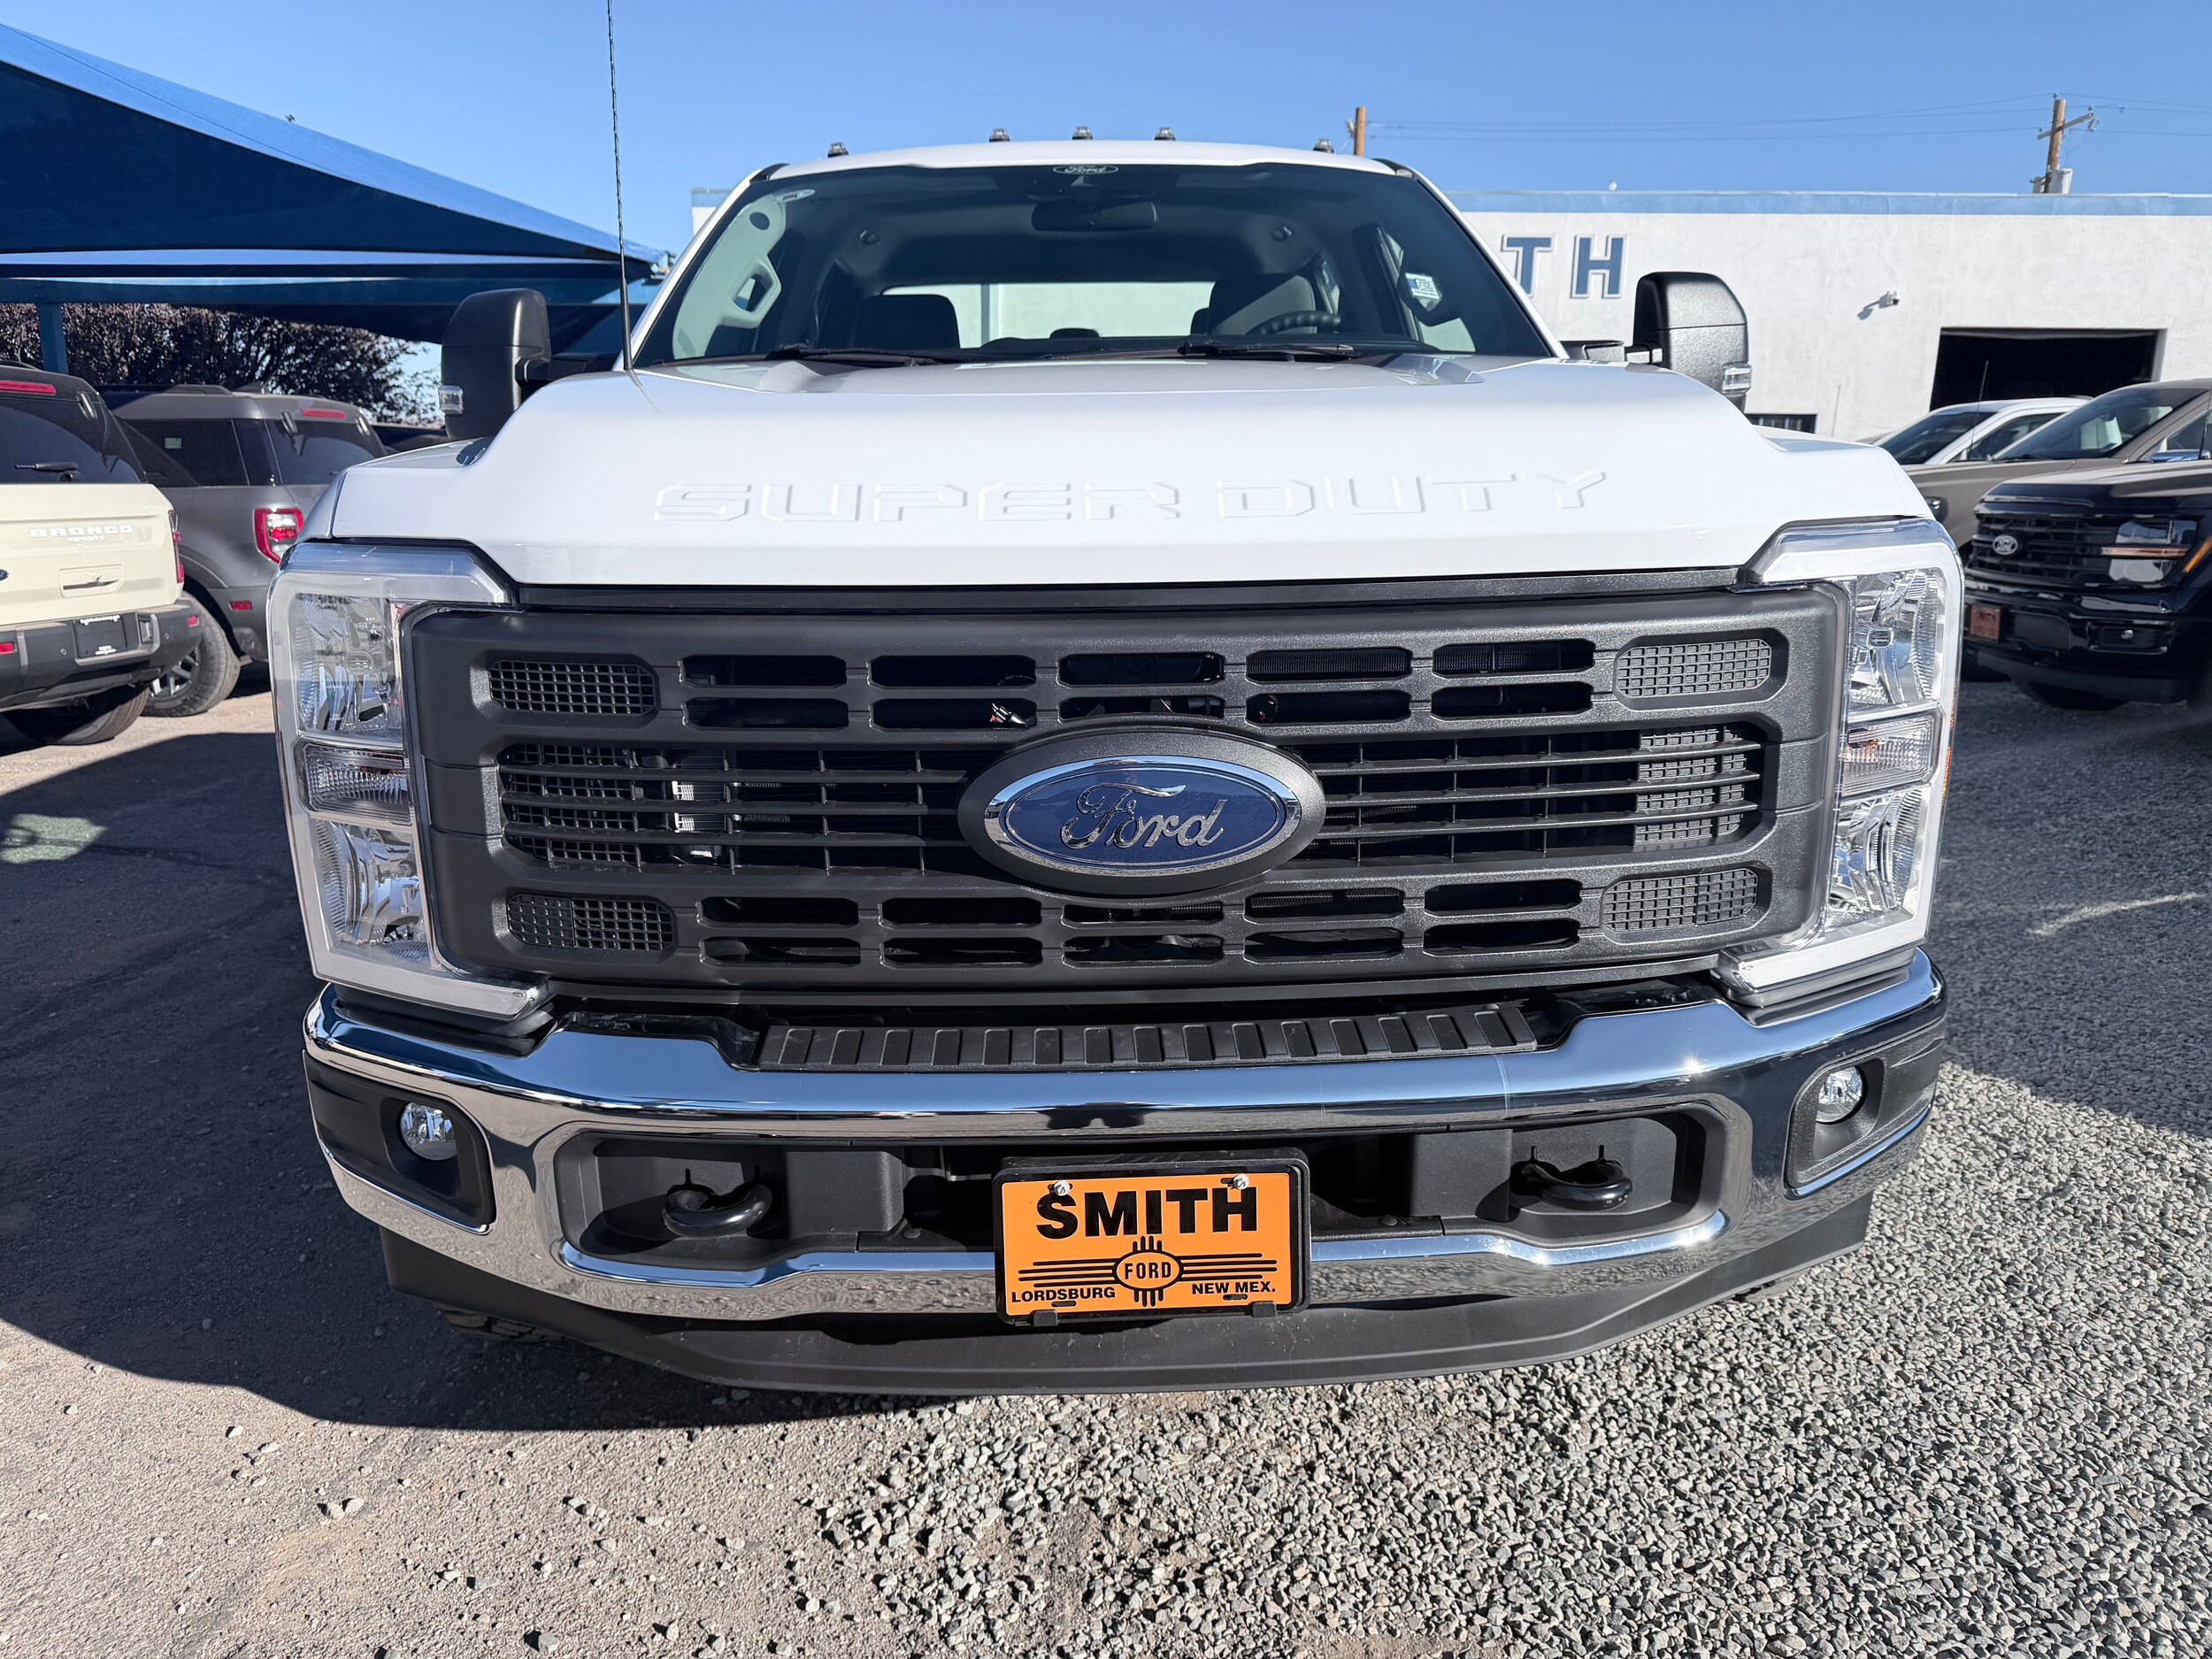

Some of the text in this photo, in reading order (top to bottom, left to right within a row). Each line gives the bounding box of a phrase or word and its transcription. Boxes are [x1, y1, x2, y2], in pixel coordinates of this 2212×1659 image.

[653, 471, 1607, 523] SUPER DUTY
[29, 525, 133, 537] BRONCO
[1060, 781, 1227, 849] Ford
[1035, 1187, 1258, 1240] SMITH
[1125, 1262, 1172, 1279] FORD
[1011, 1280, 1277, 1302] LORDSBURG NEW MEX.
